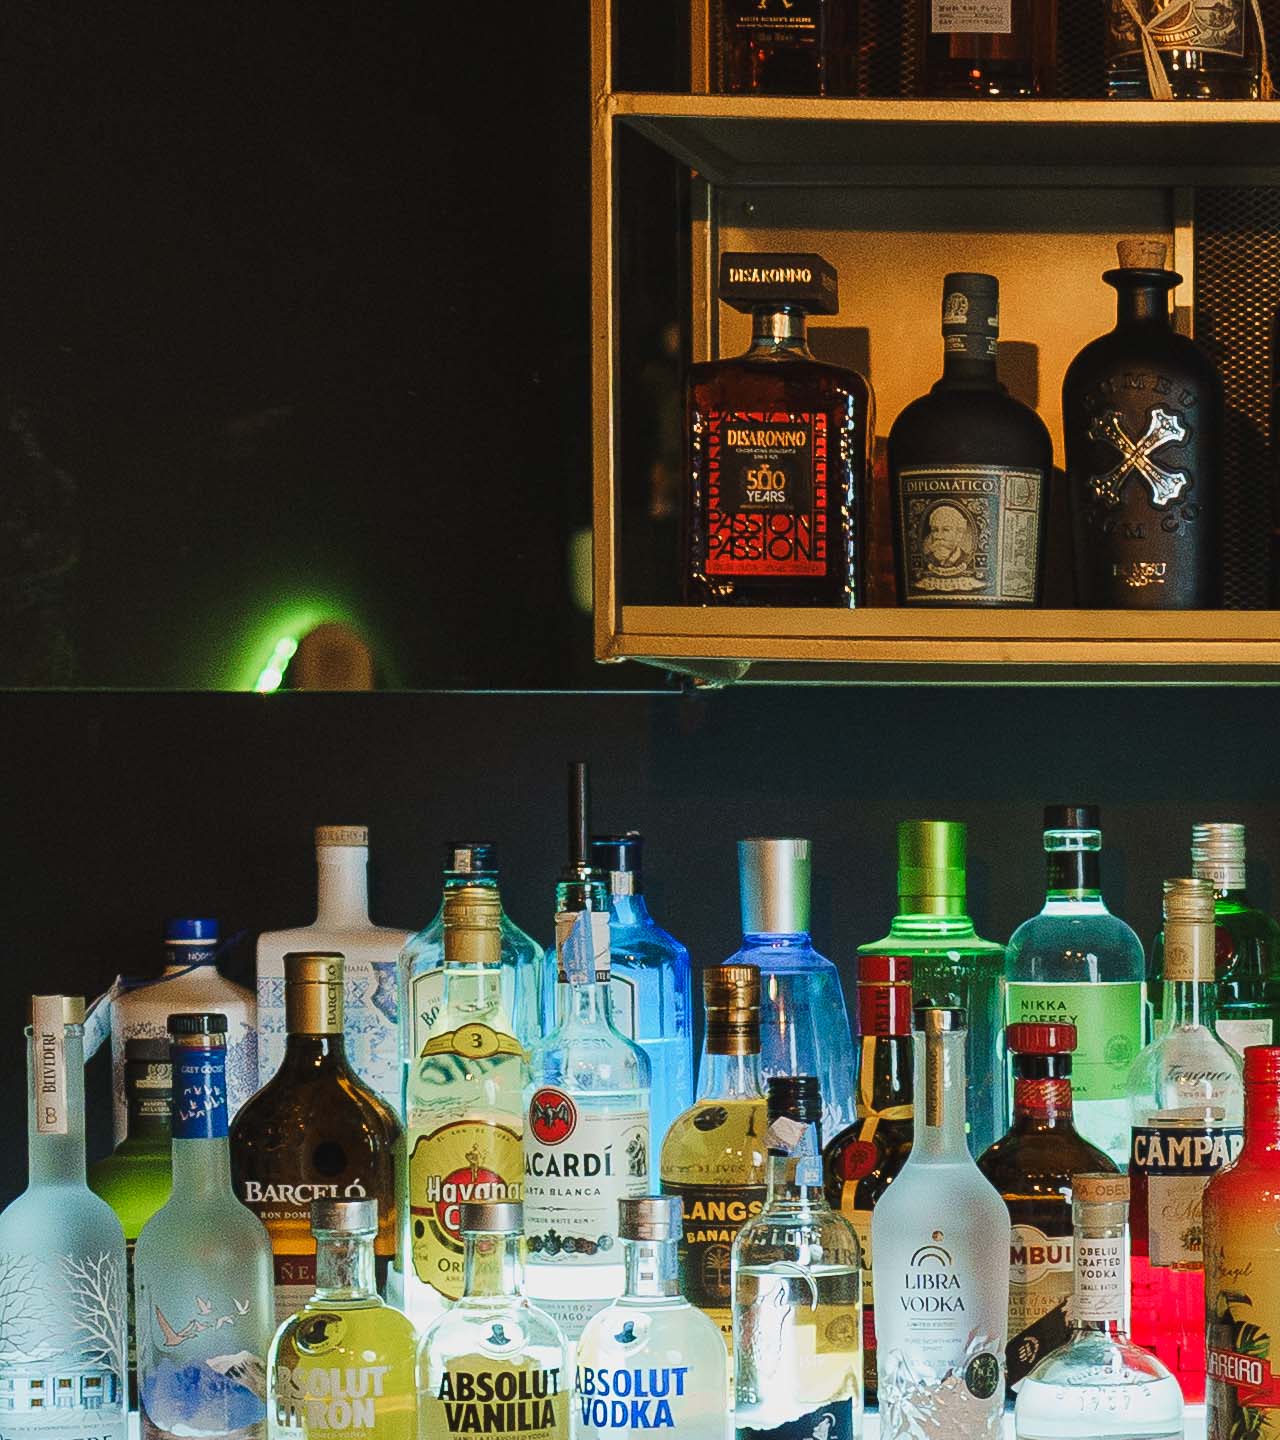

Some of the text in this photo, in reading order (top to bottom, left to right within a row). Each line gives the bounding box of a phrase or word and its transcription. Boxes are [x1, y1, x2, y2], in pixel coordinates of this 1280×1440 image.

[729, 267, 812, 284] DISARONNO
[727, 428, 808, 449] DISARONNO
[746, 490, 786, 503] YEARS
[1020, 1000, 1067, 1013] NIKKA
[1133, 1132, 1245, 1168] CAMPAR
[525, 1144, 614, 1178] ACARDÍ
[244, 1178, 367, 1205] BARCELÓ
[426, 1175, 521, 1202] Havana
[549, 1185, 602, 1196] BLANCA
[260, 1211, 281, 1220] RON
[1077, 1258, 1121, 1268] CRAFTED
[1079, 1247, 1118, 1258] OBELIU
[904, 1273, 962, 1291] LIBRA
[1080, 1270, 1118, 1279] VODKA
[900, 1295, 966, 1313] VODKA
[276, 1365, 387, 1399] BSOLUT
[437, 1367, 560, 1403] ABSOLUT
[574, 1365, 689, 1398] ABSOLUT
[276, 1397, 376, 1430] CITRON
[444, 1399, 557, 1434] VANILIA
[580, 1395, 676, 1429] VODKA
